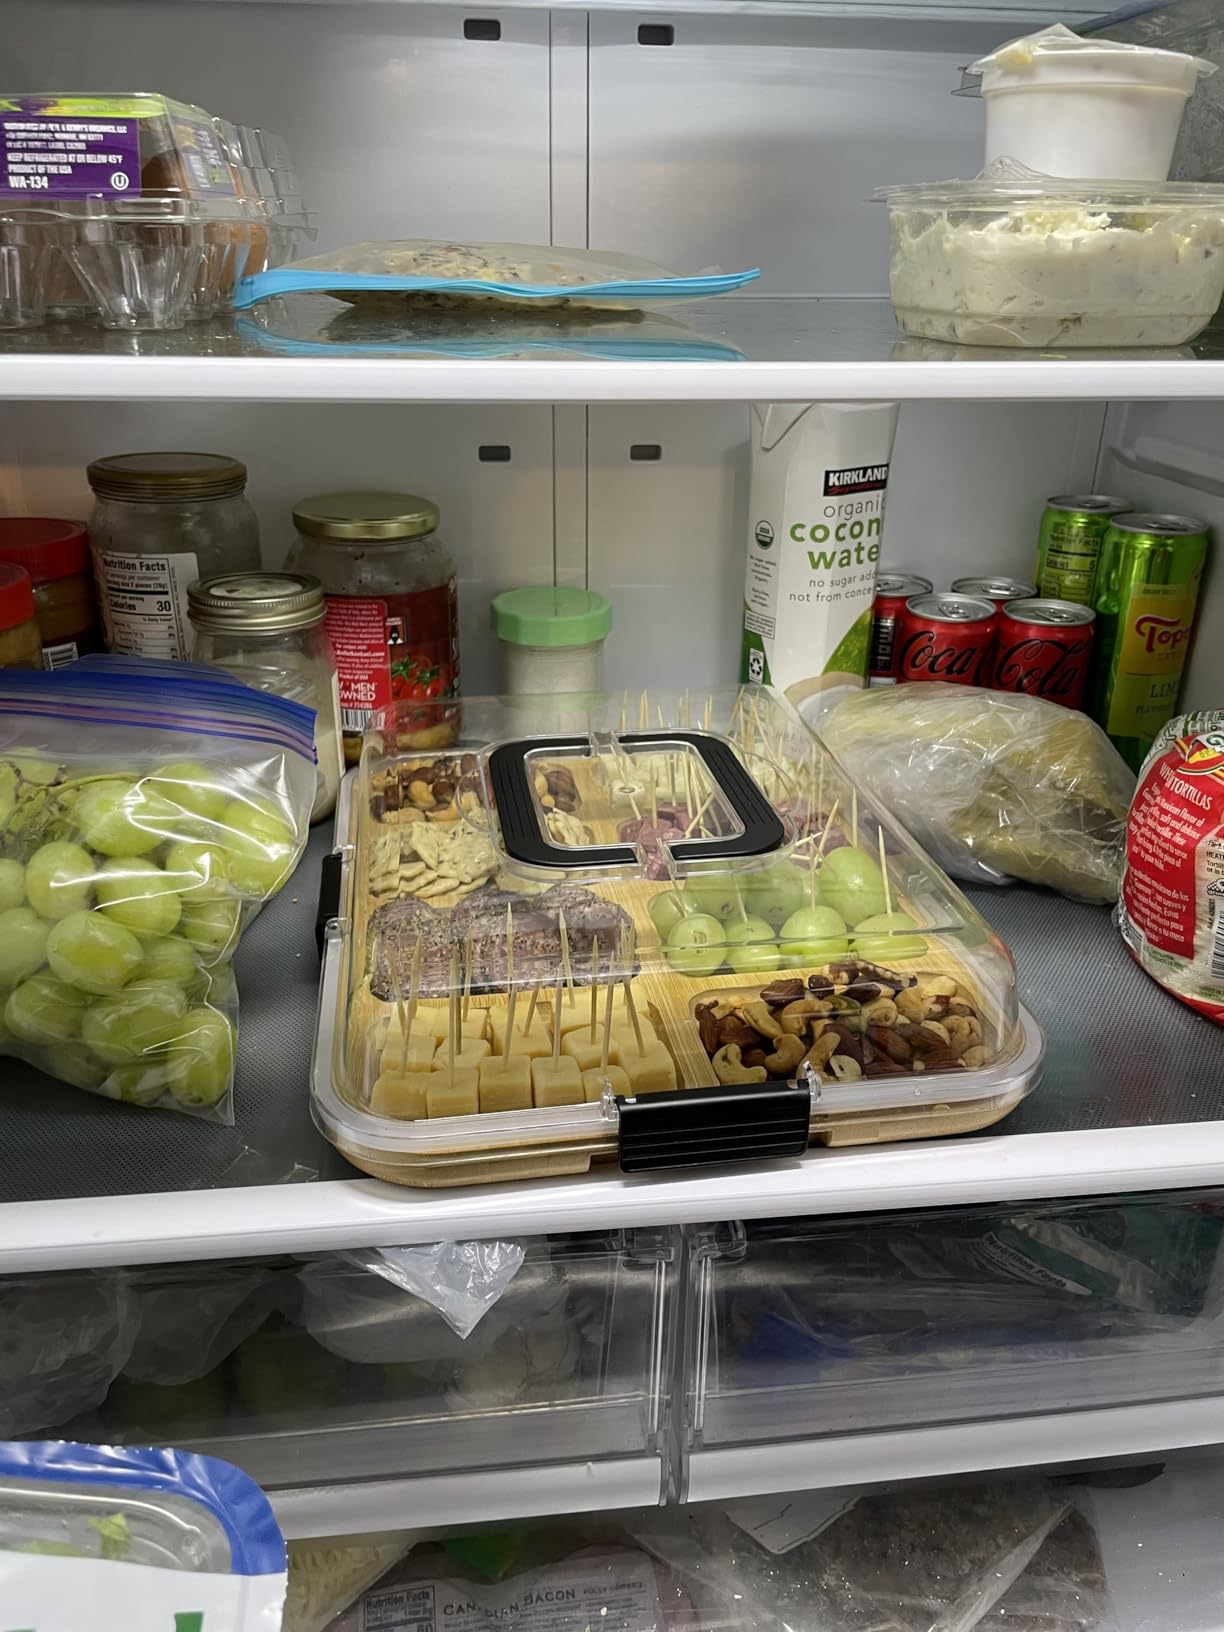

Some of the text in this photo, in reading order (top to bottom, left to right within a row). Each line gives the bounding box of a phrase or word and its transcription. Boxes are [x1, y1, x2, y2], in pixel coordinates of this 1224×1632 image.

[8, 164, 36, 173] PRODUCT
[38, 164, 46, 173] OF
[47, 165, 59, 173] THE
[9, 176, 48, 188] WA-134
[828, 466, 888, 486] KIRKLAND
[790, 517, 881, 543] cocon
[807, 542, 880, 570] wate
[139, 561, 166, 571] Facts
[1089, 559, 1095, 569] 5
[809, 580, 825, 588] no
[829, 575, 857, 588] sugar
[789, 587, 872, 602] not from conce
[156, 600, 171, 612] 30
[902, 630, 978, 680] Coca
[995, 639, 1082, 695] Cola
[339, 682, 375, 692] MEN
[1170, 778, 1212, 810] TORTILLAS
[367, 1594, 404, 1607] Nutrition
